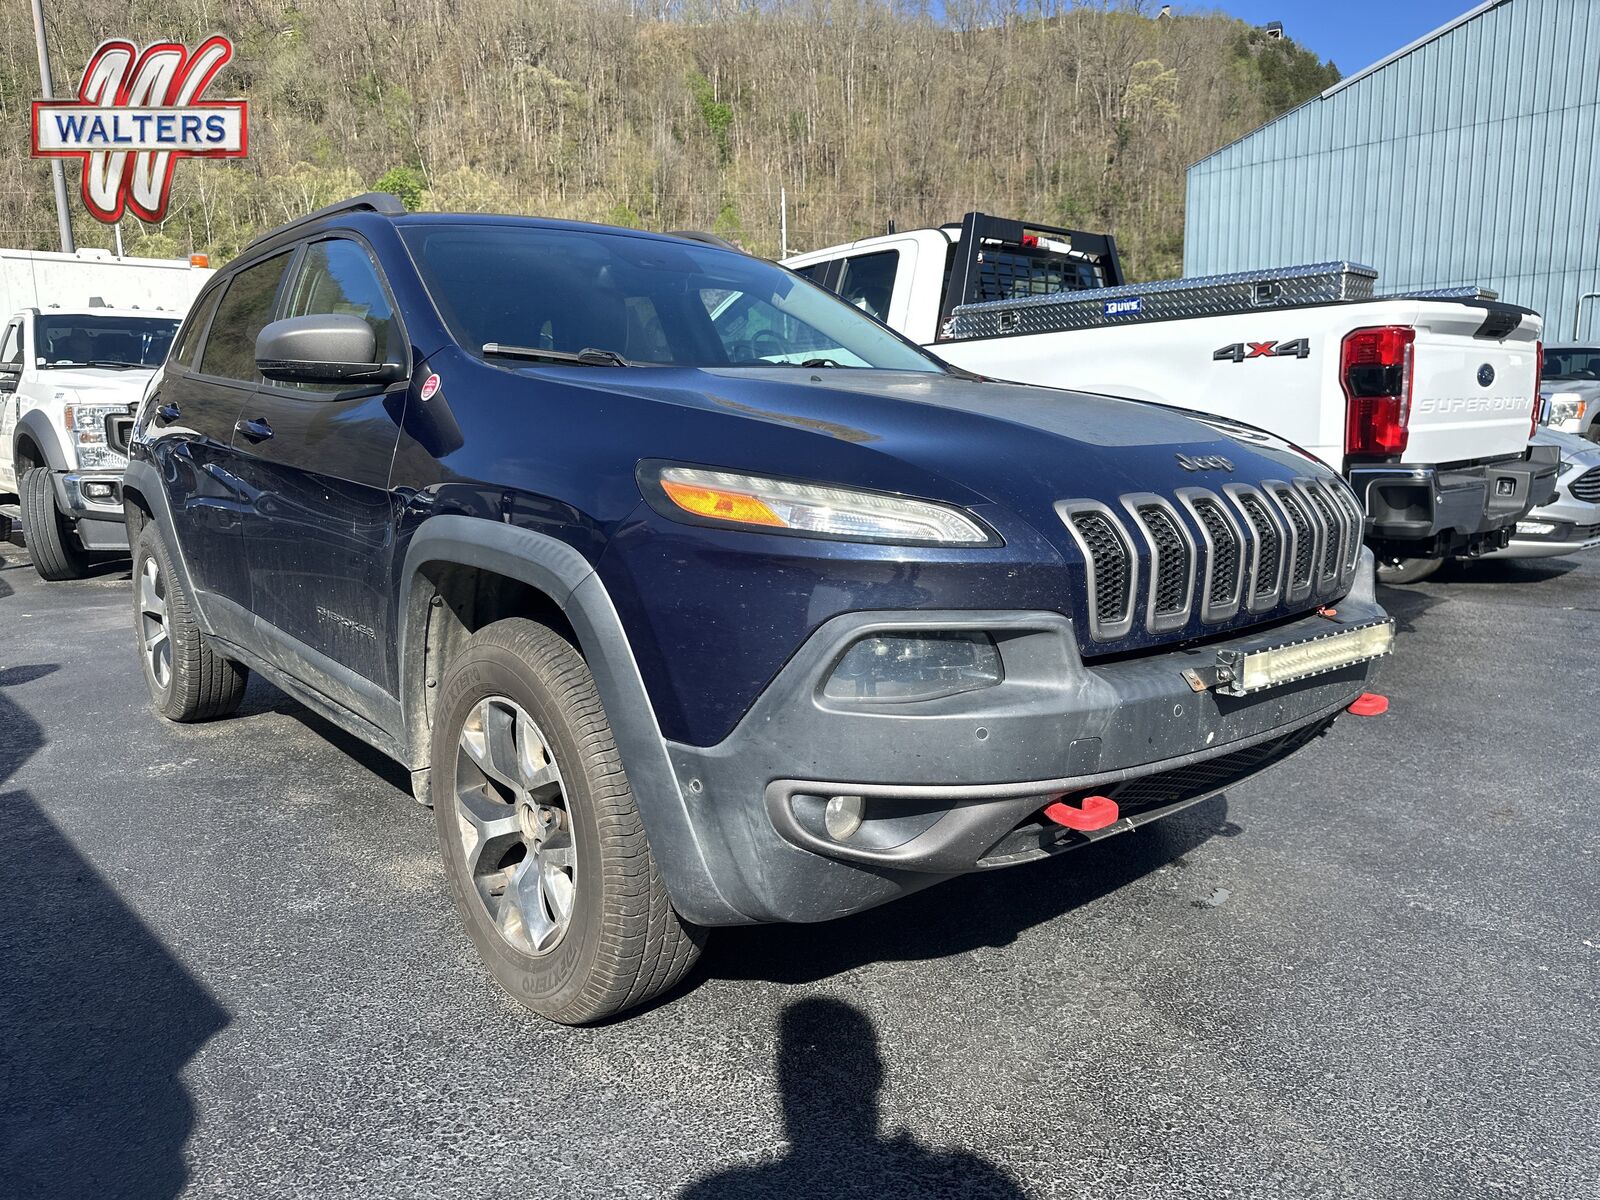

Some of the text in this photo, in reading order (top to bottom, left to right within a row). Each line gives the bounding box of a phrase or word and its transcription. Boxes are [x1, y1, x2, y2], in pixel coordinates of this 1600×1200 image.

[1419, 396, 1531, 414] SUPER DUTY
[1175, 453, 1234, 472] Jeep
